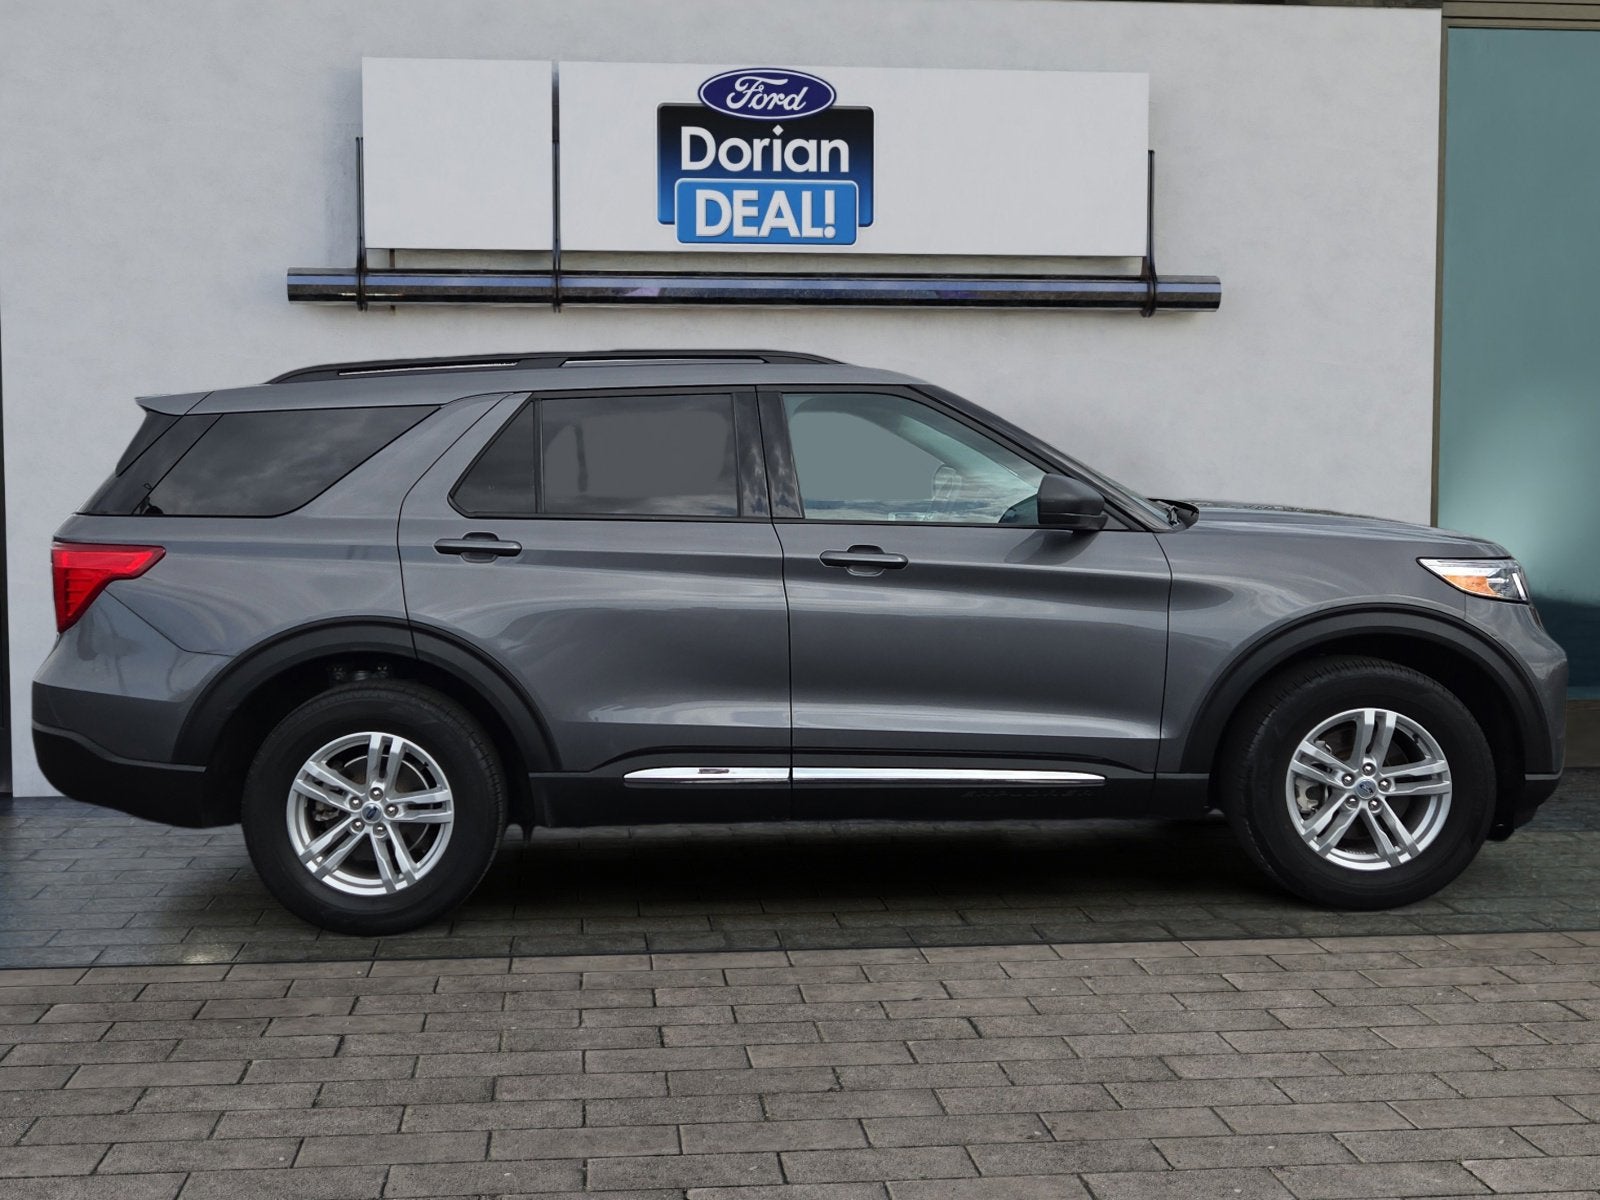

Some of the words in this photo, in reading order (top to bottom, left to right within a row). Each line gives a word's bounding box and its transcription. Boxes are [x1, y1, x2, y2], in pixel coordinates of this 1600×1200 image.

[726, 76, 808, 110] Ford
[681, 124, 849, 173] Dorian
[695, 189, 836, 239] DEAL!
